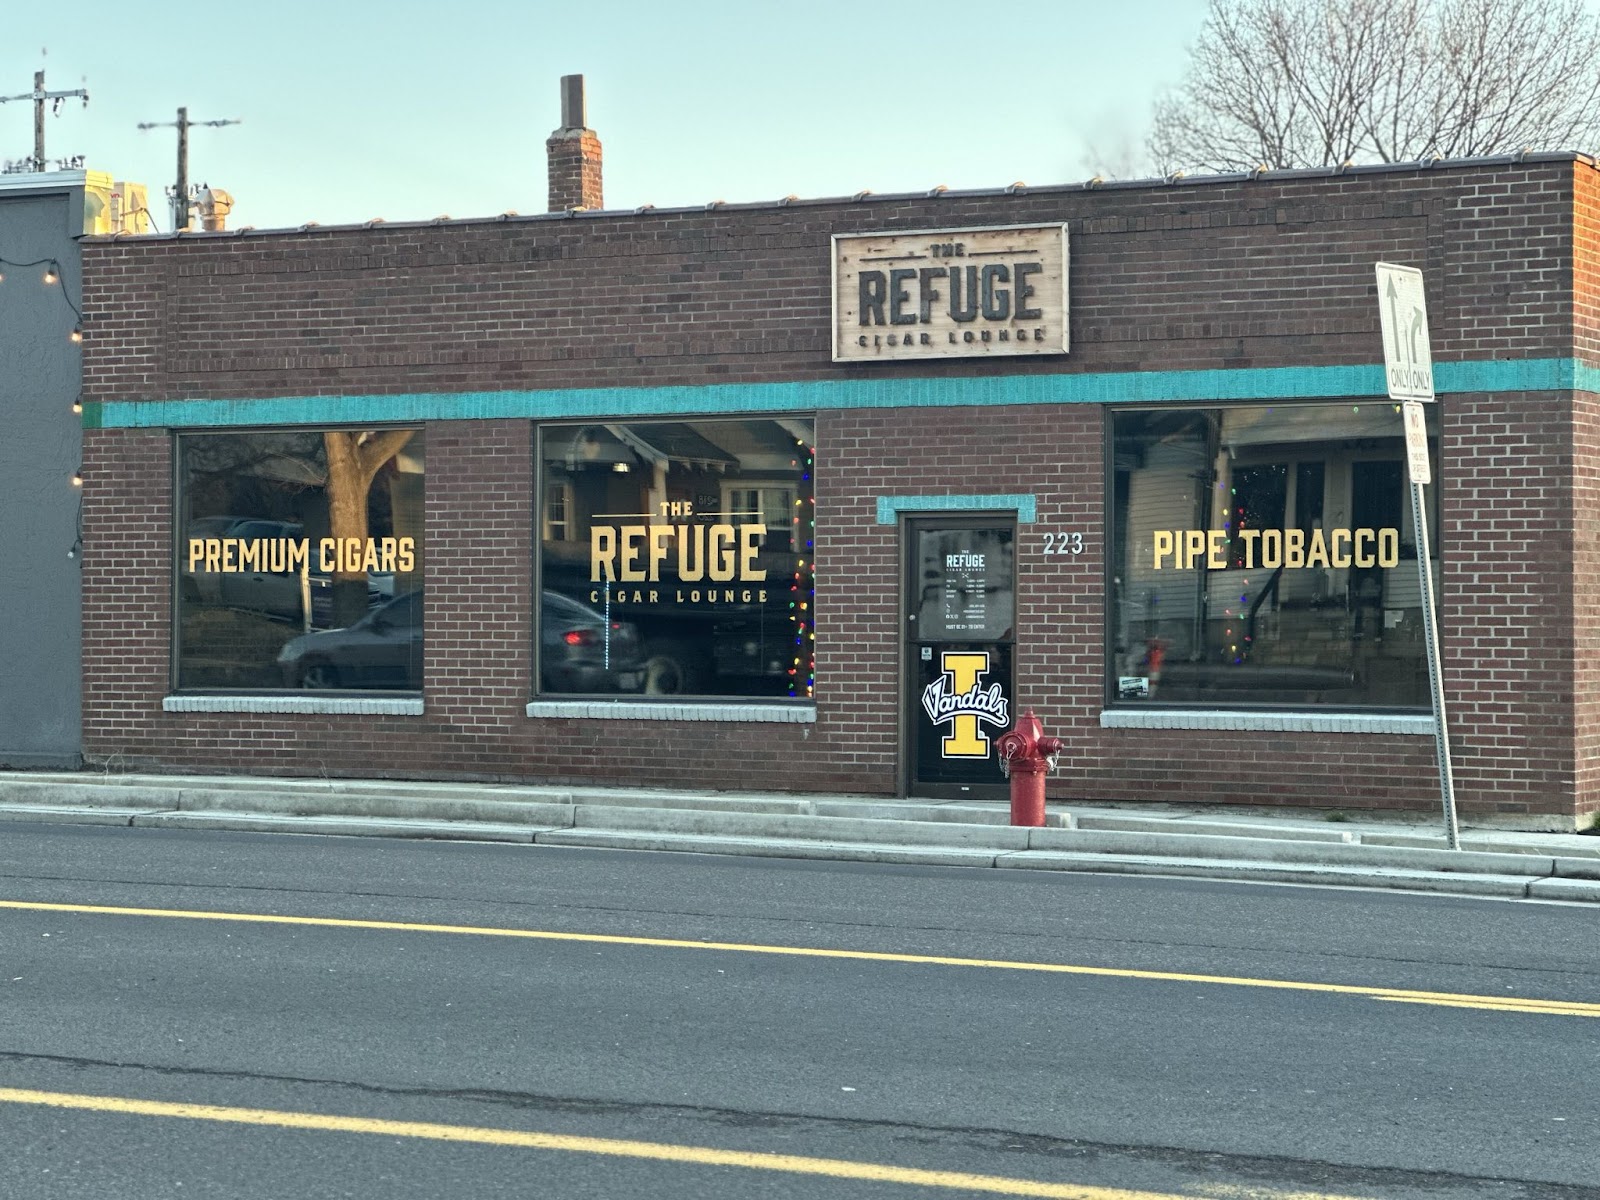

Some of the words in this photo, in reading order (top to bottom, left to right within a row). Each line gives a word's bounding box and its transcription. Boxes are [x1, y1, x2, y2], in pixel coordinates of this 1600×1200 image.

[930, 243, 965, 258] THE
[858, 262, 1043, 326] REFUGE
[858, 332, 931, 348] CIGAR
[949, 328, 1045, 344] LOUNGE
[1390, 368, 1410, 388] ONLY
[1412, 370, 1430, 390] ONLY
[660, 501, 693, 517] THE
[590, 523, 768, 582] REFUGE
[1042, 532, 1084, 555] 223
[1153, 529, 1228, 570] PIPE
[1238, 527, 1399, 569] TOBACCO
[189, 538, 310, 573] PREMIUM
[319, 537, 415, 572] CIGARS
[946, 554, 985, 567] REFUGE
[590, 590, 659, 603] CIGAR
[676, 590, 768, 603] LOUNGE
[922, 675, 1009, 727] Vandals
